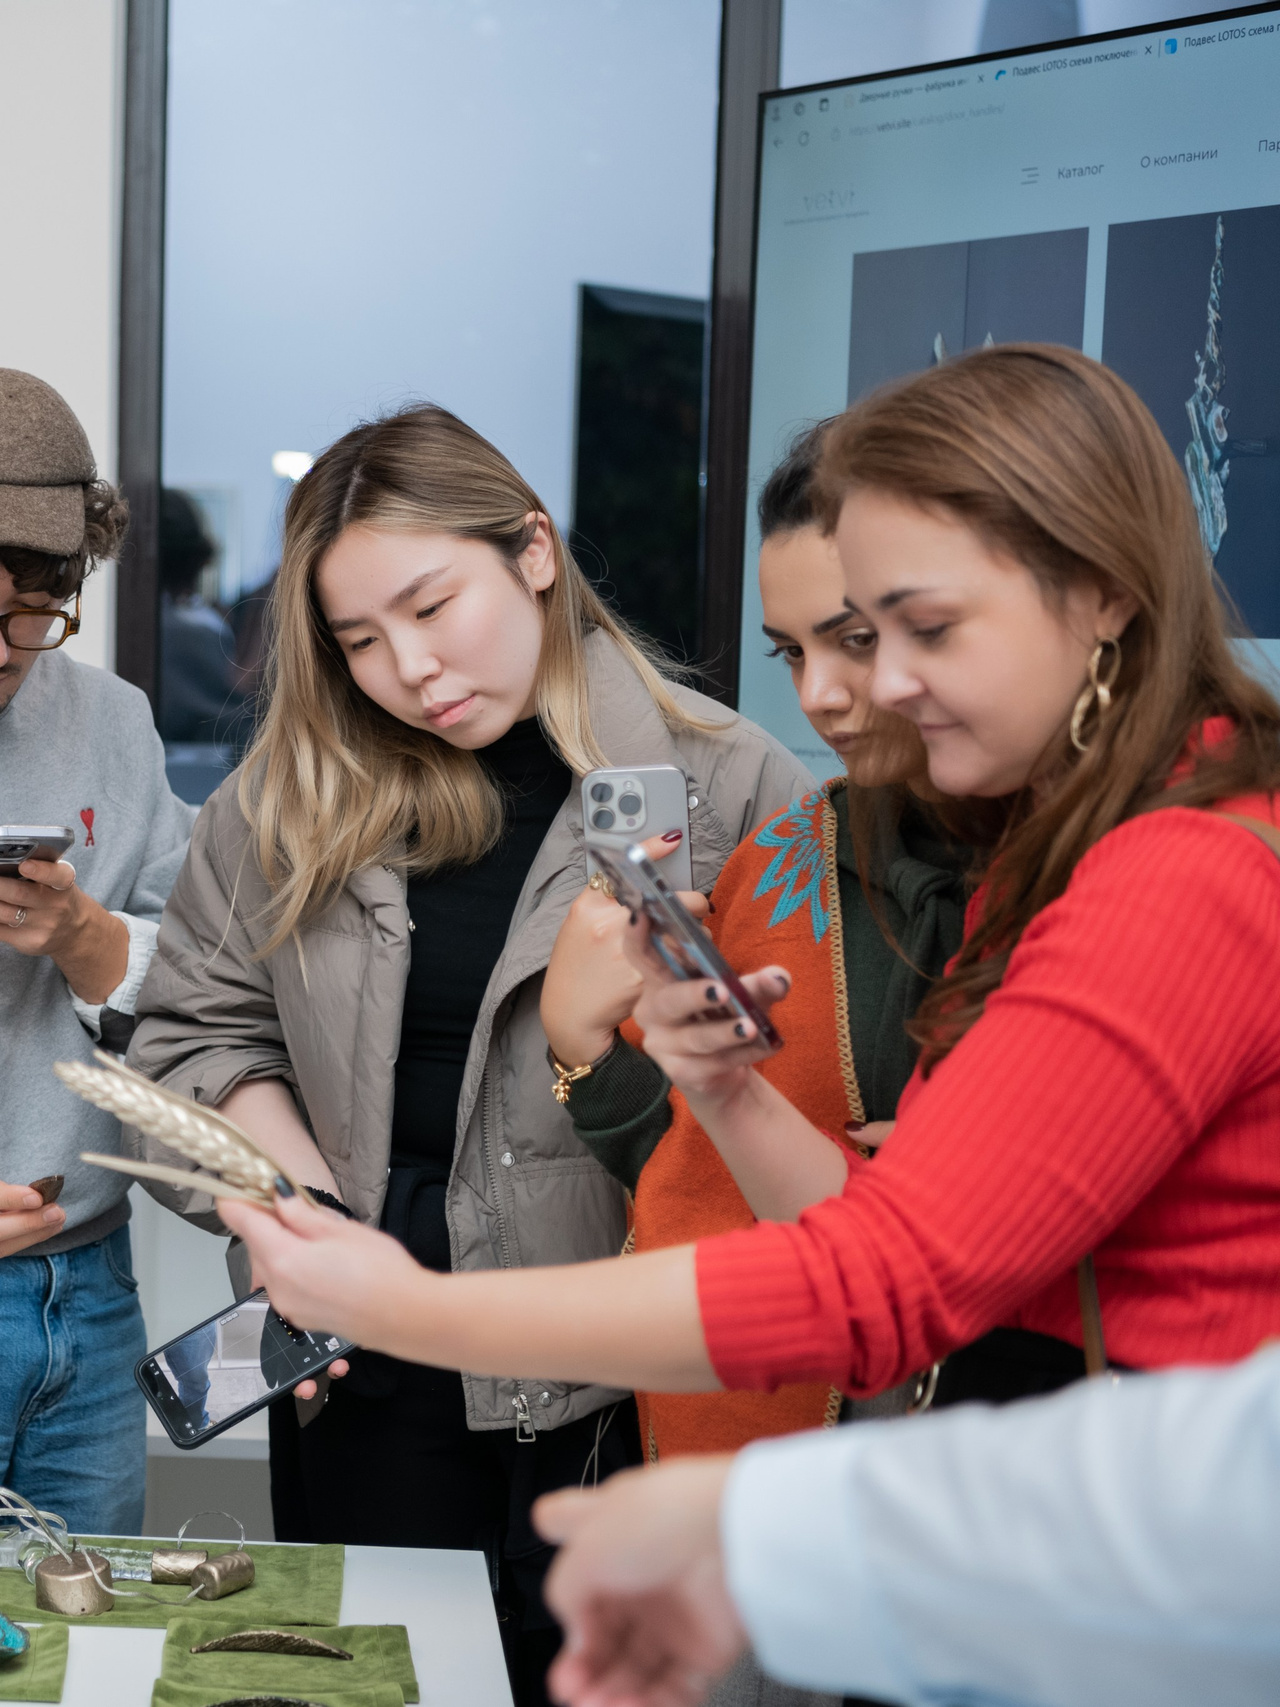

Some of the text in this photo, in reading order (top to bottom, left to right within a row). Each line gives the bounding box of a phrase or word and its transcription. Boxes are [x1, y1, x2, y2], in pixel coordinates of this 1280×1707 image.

[1184, 34, 1216, 48] Подвес
[1218, 27, 1246, 42] LOTOS
[1248, 24, 1274, 36] схема
[1012, 65, 1041, 77] Подвес
[1043, 58, 1067, 72] LOTOS
[1069, 56, 1092, 67] схема
[1140, 148, 1218, 169] О компании
[1057, 162, 1104, 180] Каталог
